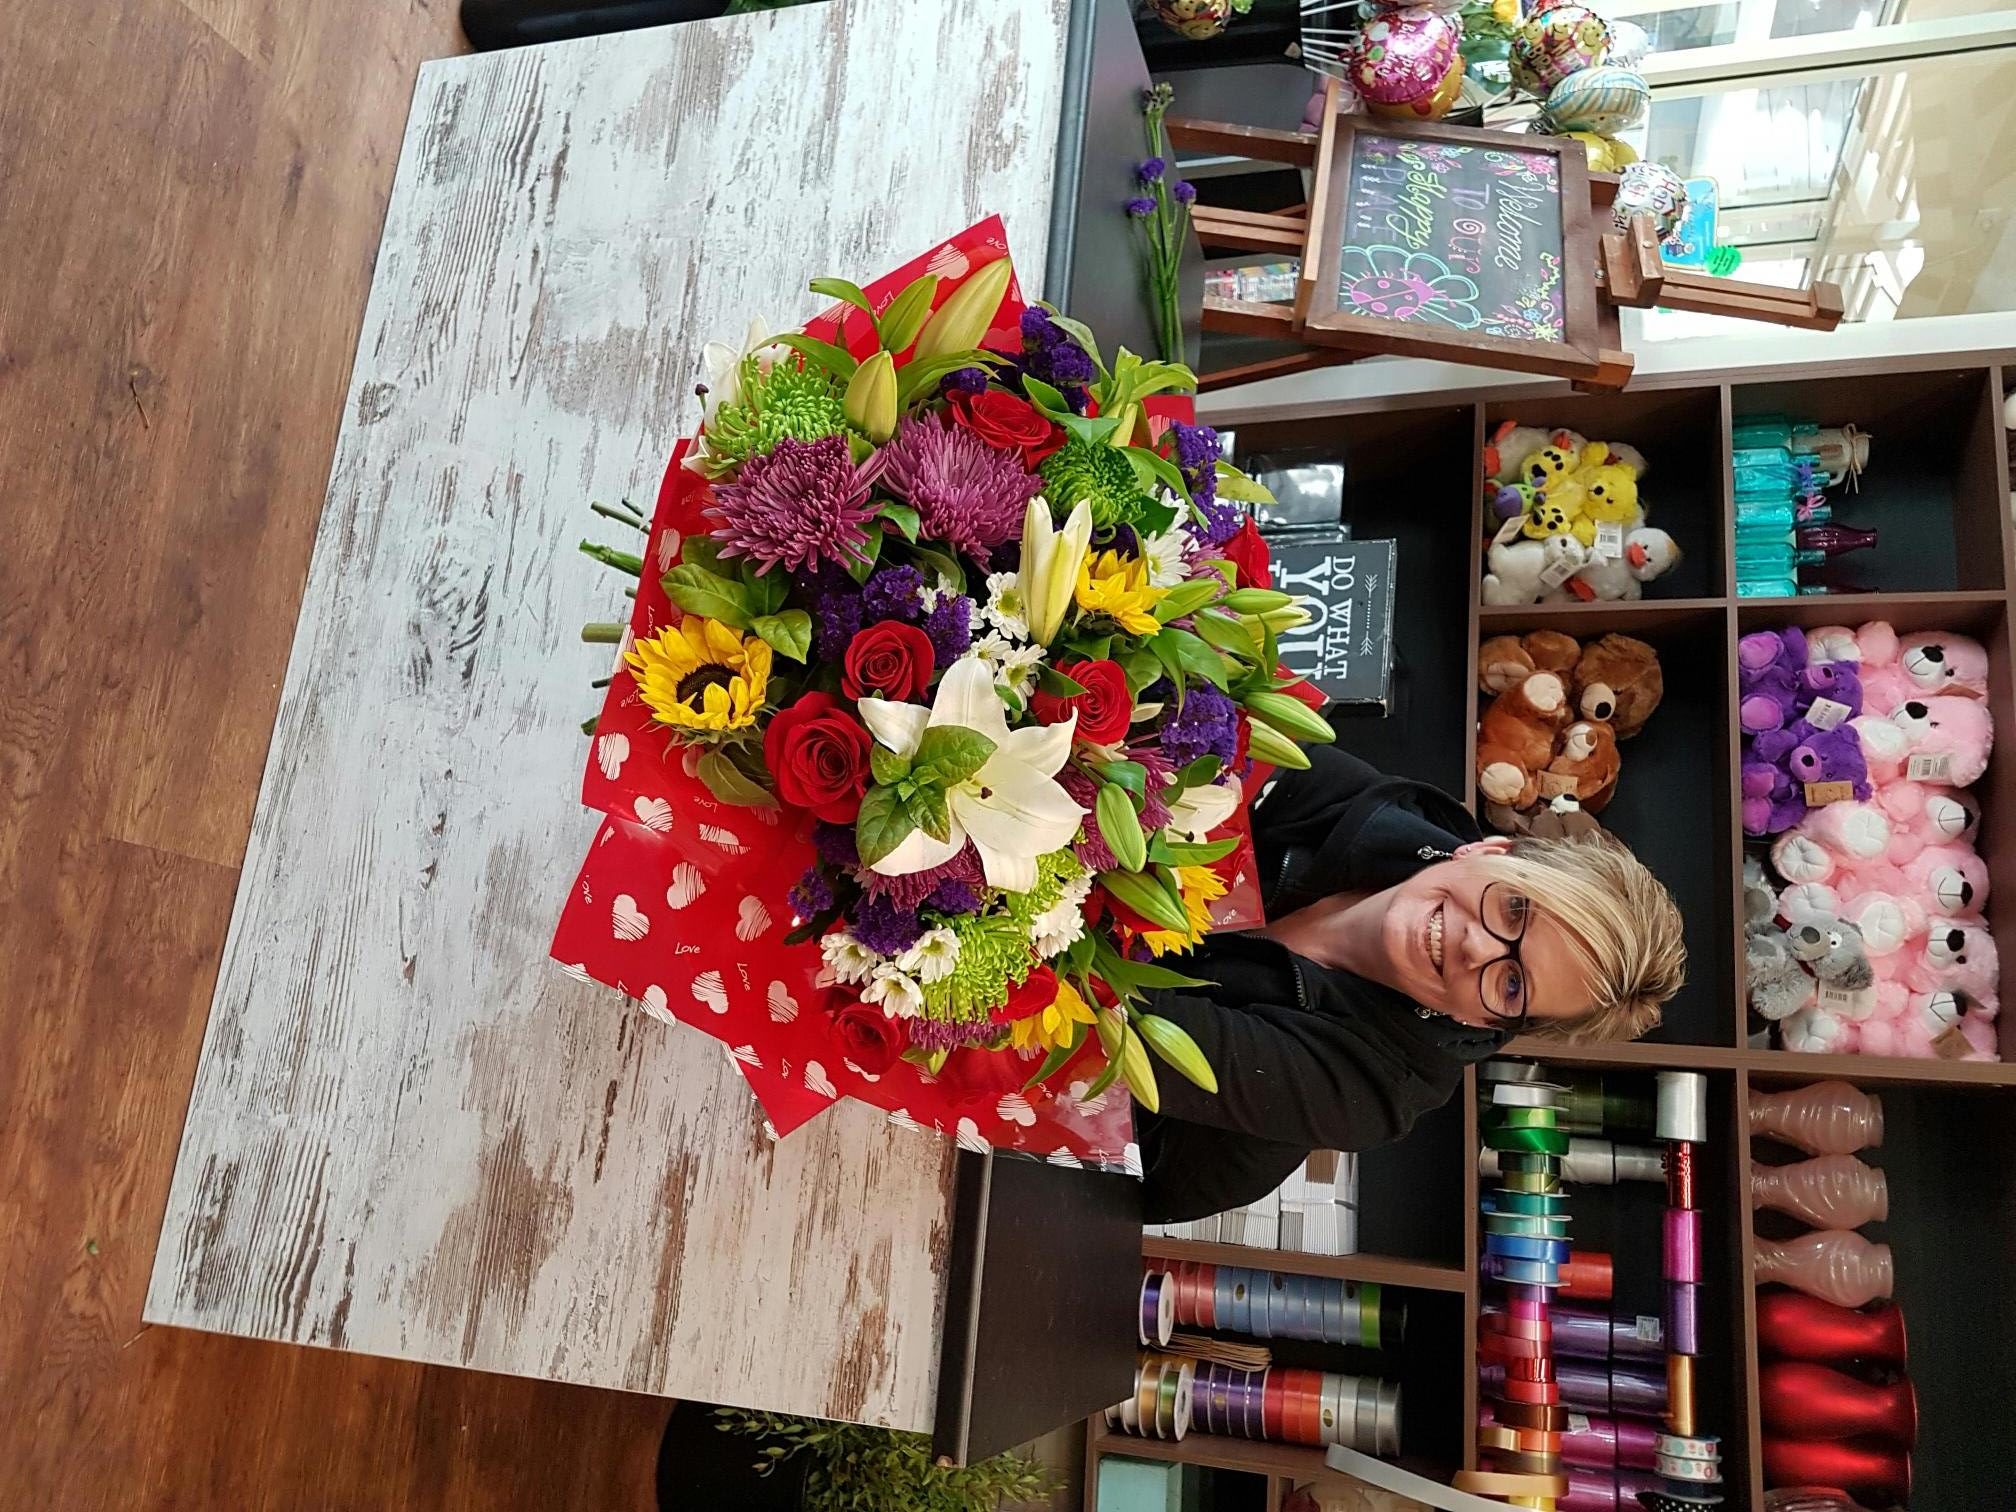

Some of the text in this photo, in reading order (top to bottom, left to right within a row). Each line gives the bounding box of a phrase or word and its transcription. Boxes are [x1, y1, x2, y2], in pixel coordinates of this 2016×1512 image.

[1351, 164, 1406, 242] PLACE
[1386, 170, 1447, 250] Happy
[1450, 184, 1490, 210] TO
[1494, 180, 1545, 270] Welcome
[1276, 556, 1332, 681] YOU
[1323, 556, 1356, 680] DO WHAT
[692, 796, 718, 813] Love
[582, 874, 592, 904] ove
[674, 942, 701, 955] Love
[736, 962, 752, 992] Love
[1037, 1082, 1054, 1099] ove
